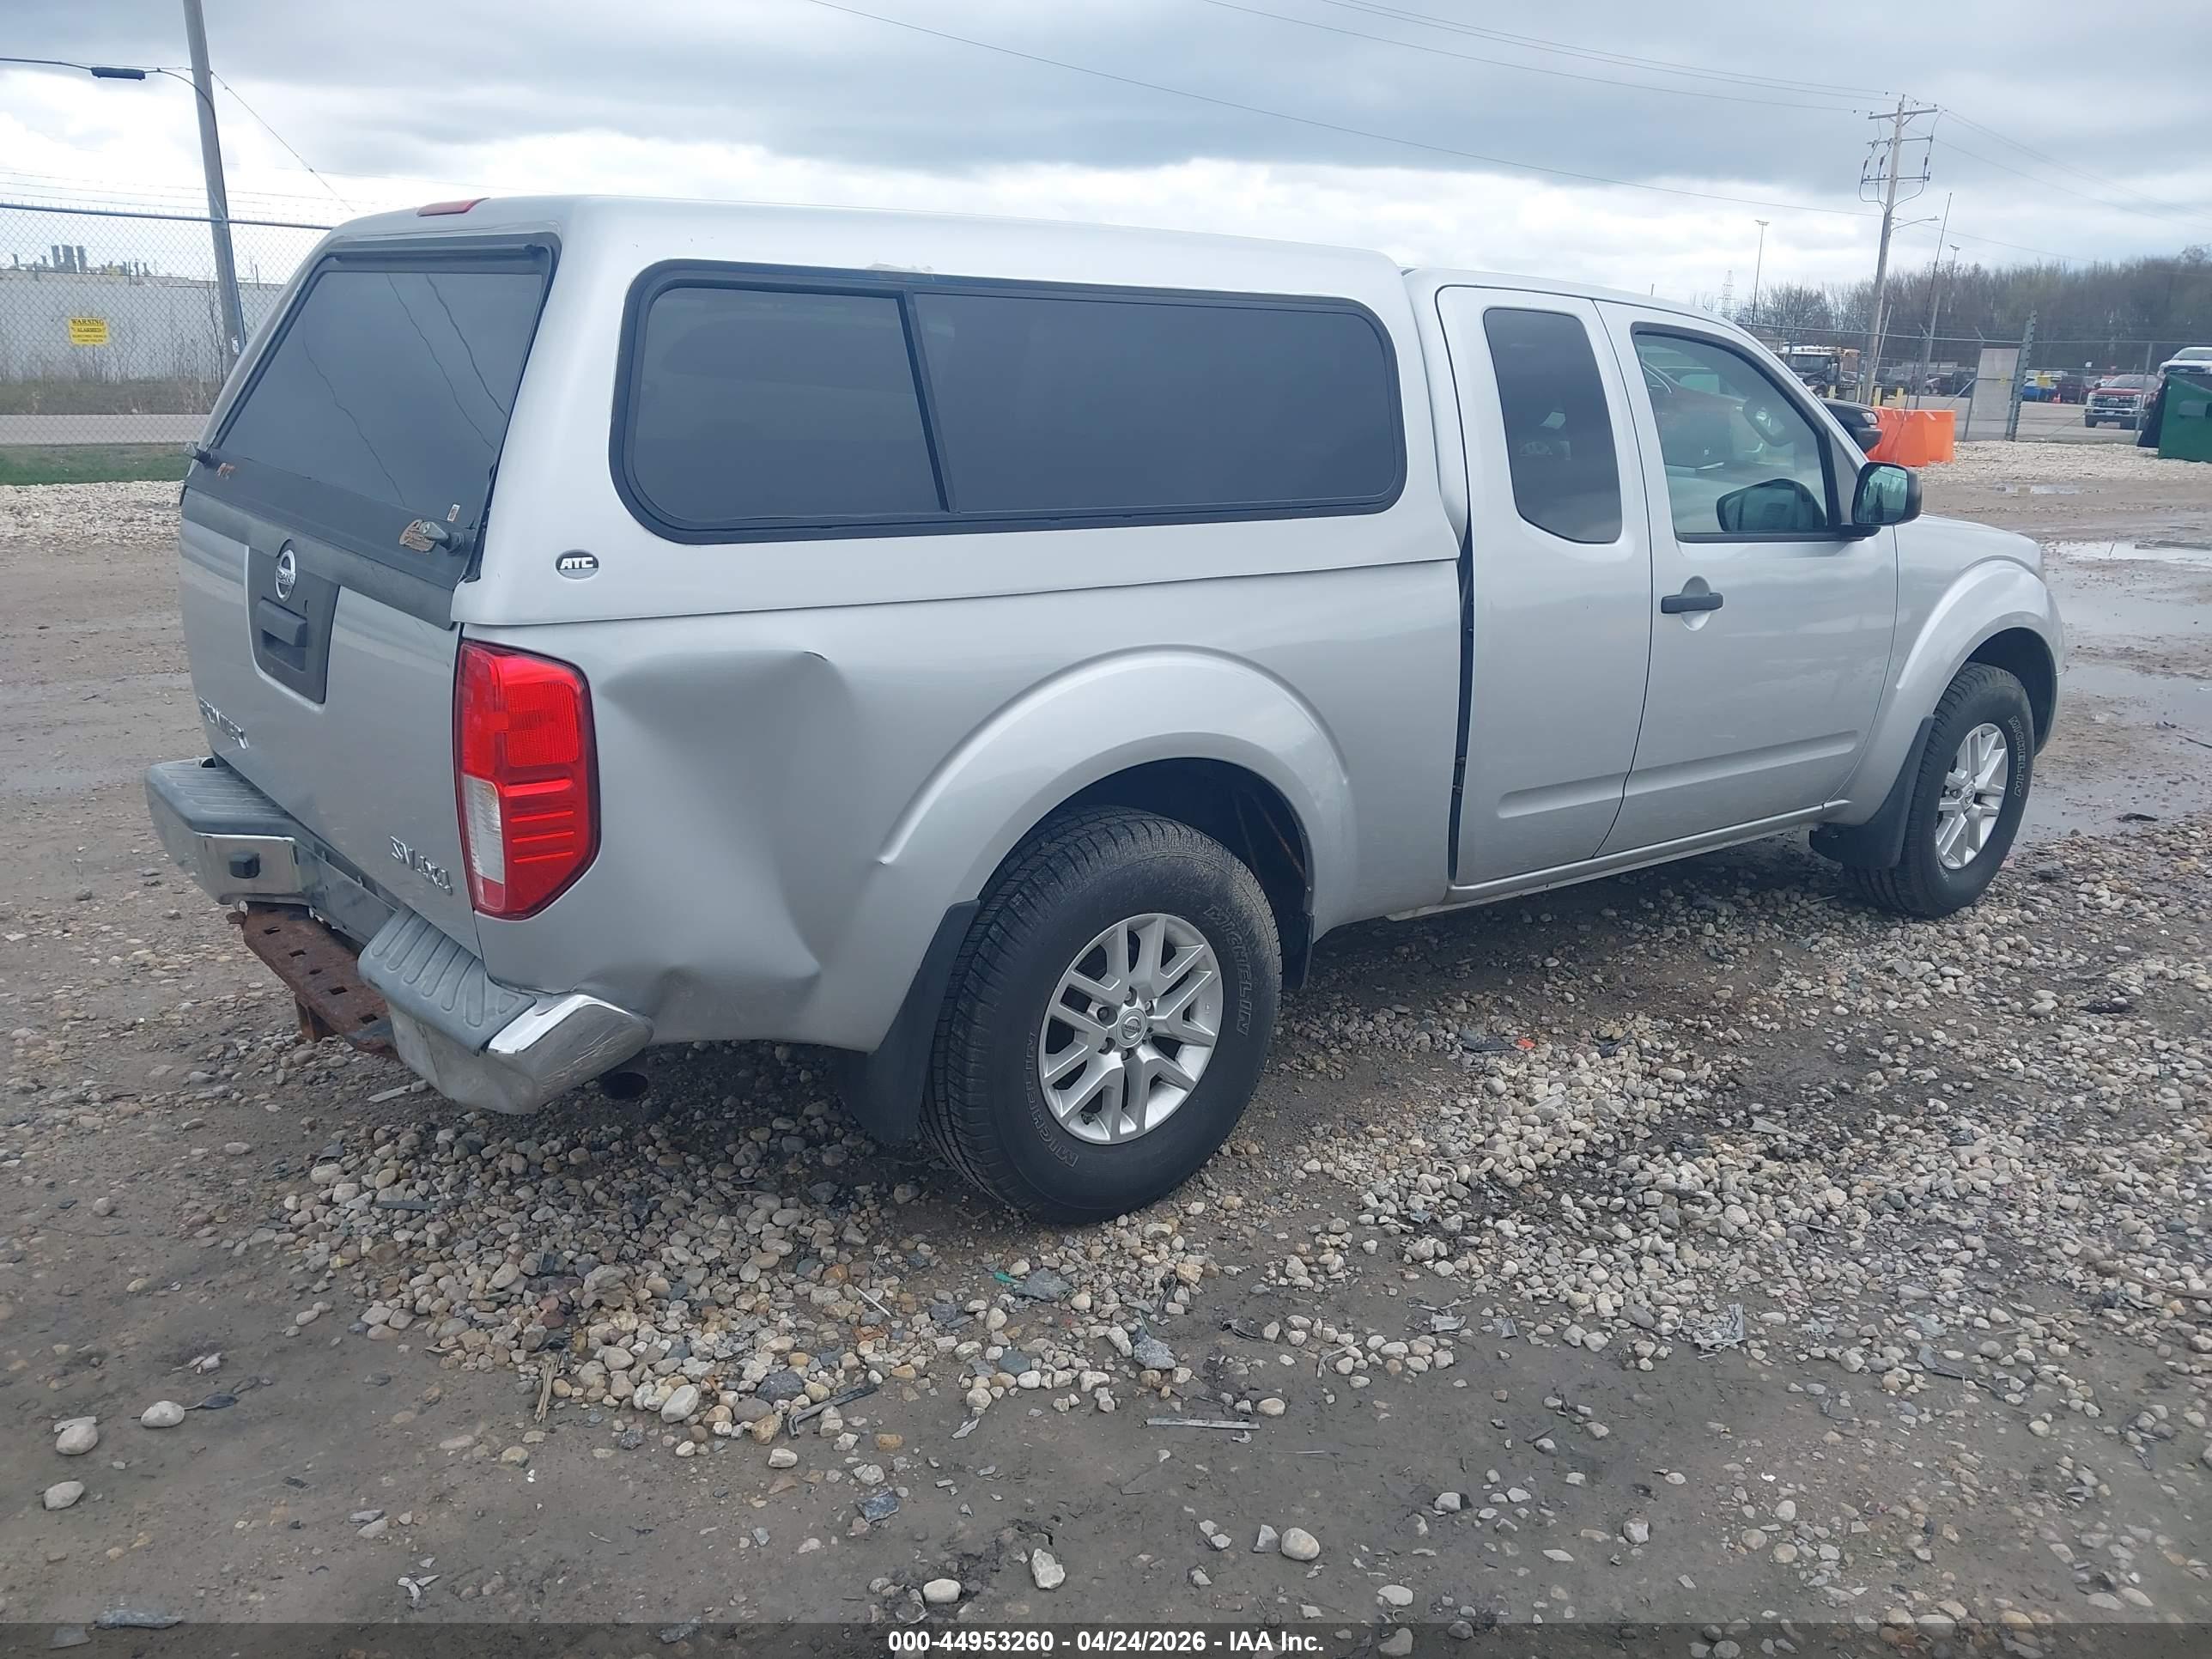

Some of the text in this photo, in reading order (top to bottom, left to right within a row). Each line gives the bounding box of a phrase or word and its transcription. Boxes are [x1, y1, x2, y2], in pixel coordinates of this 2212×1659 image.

[560, 556, 593, 569] ATC
[2008, 715, 2027, 798] MICHELIN
[1204, 906, 1253, 1036] MICHELIN
[1025, 1032, 1079, 1168] MICHELIN
